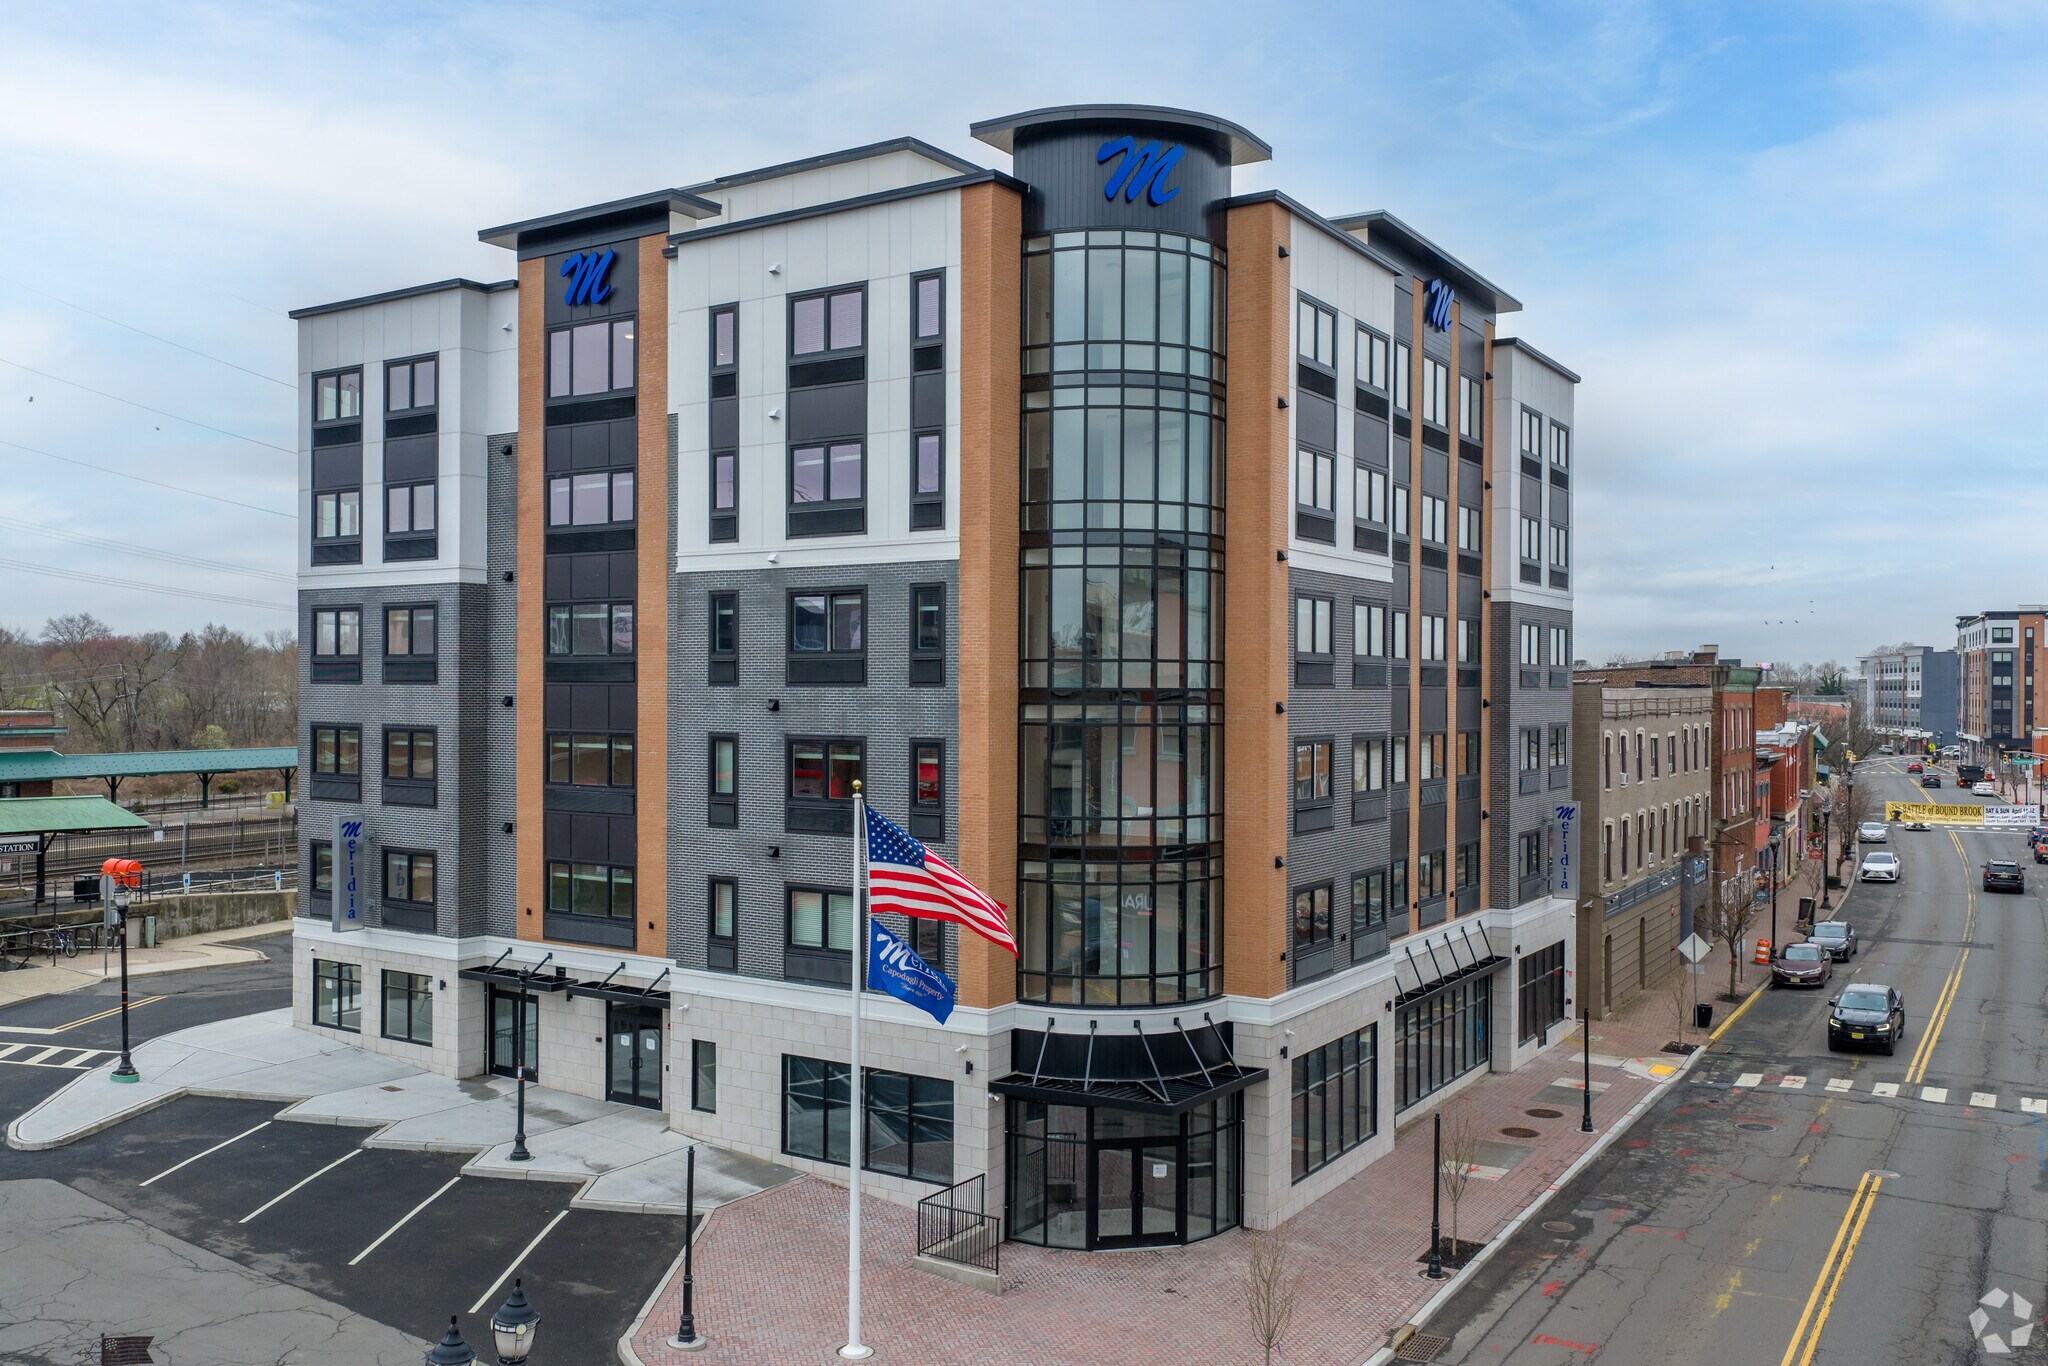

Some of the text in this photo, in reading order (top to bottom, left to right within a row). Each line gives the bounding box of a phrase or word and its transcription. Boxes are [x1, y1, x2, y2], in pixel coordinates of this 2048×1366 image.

[1097, 136, 1185, 206] M
[561, 248, 615, 306] M
[1902, 804, 1926, 815] BATTLE
[1927, 805, 1935, 815] of
[1935, 805, 1958, 816] BOUND
[1960, 806, 1982, 817] BROOK
[0, 843, 34, 852] STATION
[341, 821, 362, 919] Meridia
[1556, 806, 1575, 889] Meridia
[882, 964, 919, 985] Capodagli
[919, 980, 945, 1001] Property
